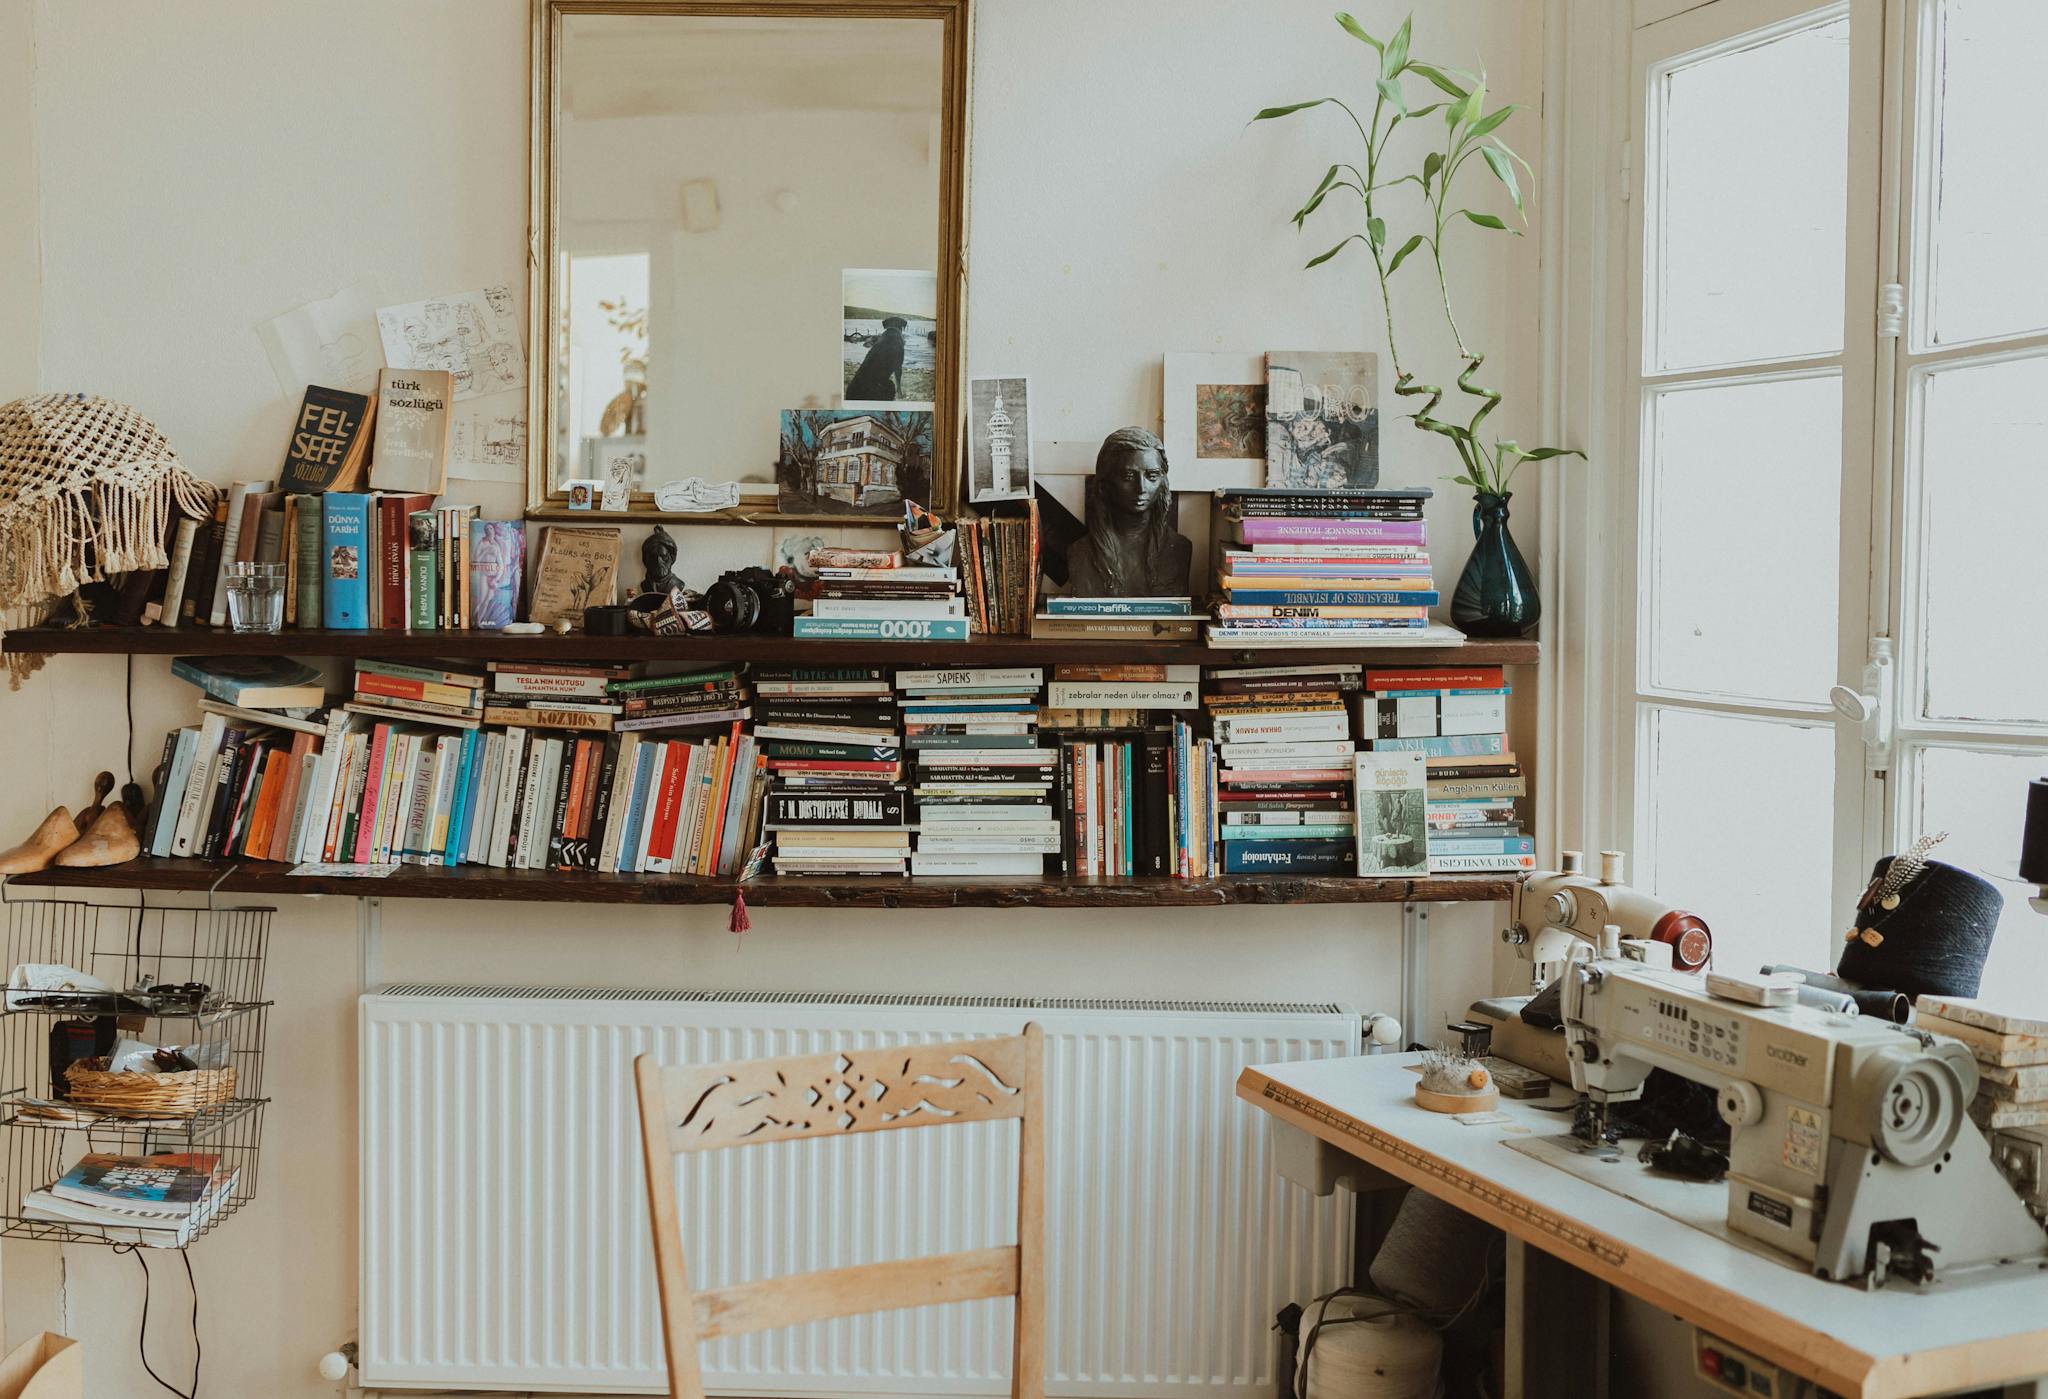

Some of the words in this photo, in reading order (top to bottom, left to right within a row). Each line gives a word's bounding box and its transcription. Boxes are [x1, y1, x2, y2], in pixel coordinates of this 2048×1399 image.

[391, 380, 421, 391] türk
[300, 403, 353, 437] FEL-
[291, 432, 347, 465] SEFE
[328, 514, 360, 524] DÜNYA
[329, 525, 359, 534] TARİHİ
[1279, 527, 1321, 536] ITALIENNE
[1325, 528, 1382, 536] RENAISSANCE
[550, 547, 578, 558] FLEURS
[594, 551, 613, 561] BOIS
[420, 566, 428, 591] DÜNYA
[1284, 592, 1328, 603] ISTANBUL
[1331, 593, 1343, 603] OF
[1347, 593, 1400, 603] TREASURES
[1272, 607, 1319, 618] DENIM
[880, 621, 932, 638] 1000
[555, 678, 585, 686] KUTUSU
[937, 672, 971, 684] SAPIENS
[1068, 690, 1102, 699] zebralar
[1104, 691, 1128, 699] neden
[1130, 690, 1150, 699] ülser
[1152, 691, 1180, 699] olmaz?
[537, 711, 597, 726] KOZMOS
[1236, 725, 1258, 734] PAMUK
[1260, 725, 1282, 734] ORHAN
[780, 744, 814, 755] MOMO
[530, 753, 539, 777] NIETZSCHE
[416, 768, 432, 783] İYİ
[517, 766, 525, 787] Öğrenme
[558, 764, 571, 800] Günübirlik
[667, 767, 678, 796] Sofie'nin
[527, 783, 535, 800] BÖYLE
[599, 790, 607, 802] Patti
[1442, 784, 1489, 794] Angela'nın
[409, 783, 429, 830] HİSSETMEK
[595, 802, 605, 820] Smith
[662, 796, 673, 820] dünyası
[779, 800, 786, 819] F.
[788, 800, 797, 819] M.
[798, 798, 848, 820] DOSTOYEVSKİ
[854, 800, 884, 820] BUDALA
[524, 801, 532, 827] BUYURDU
[553, 801, 566, 830] Hayatlar
[520, 828, 529, 851] ZERDÜŞT
[1242, 851, 1292, 864] FerhAntoloji
[1440, 860, 1492, 868] YANILGISI
[1766, 1044, 1809, 1067] brother
